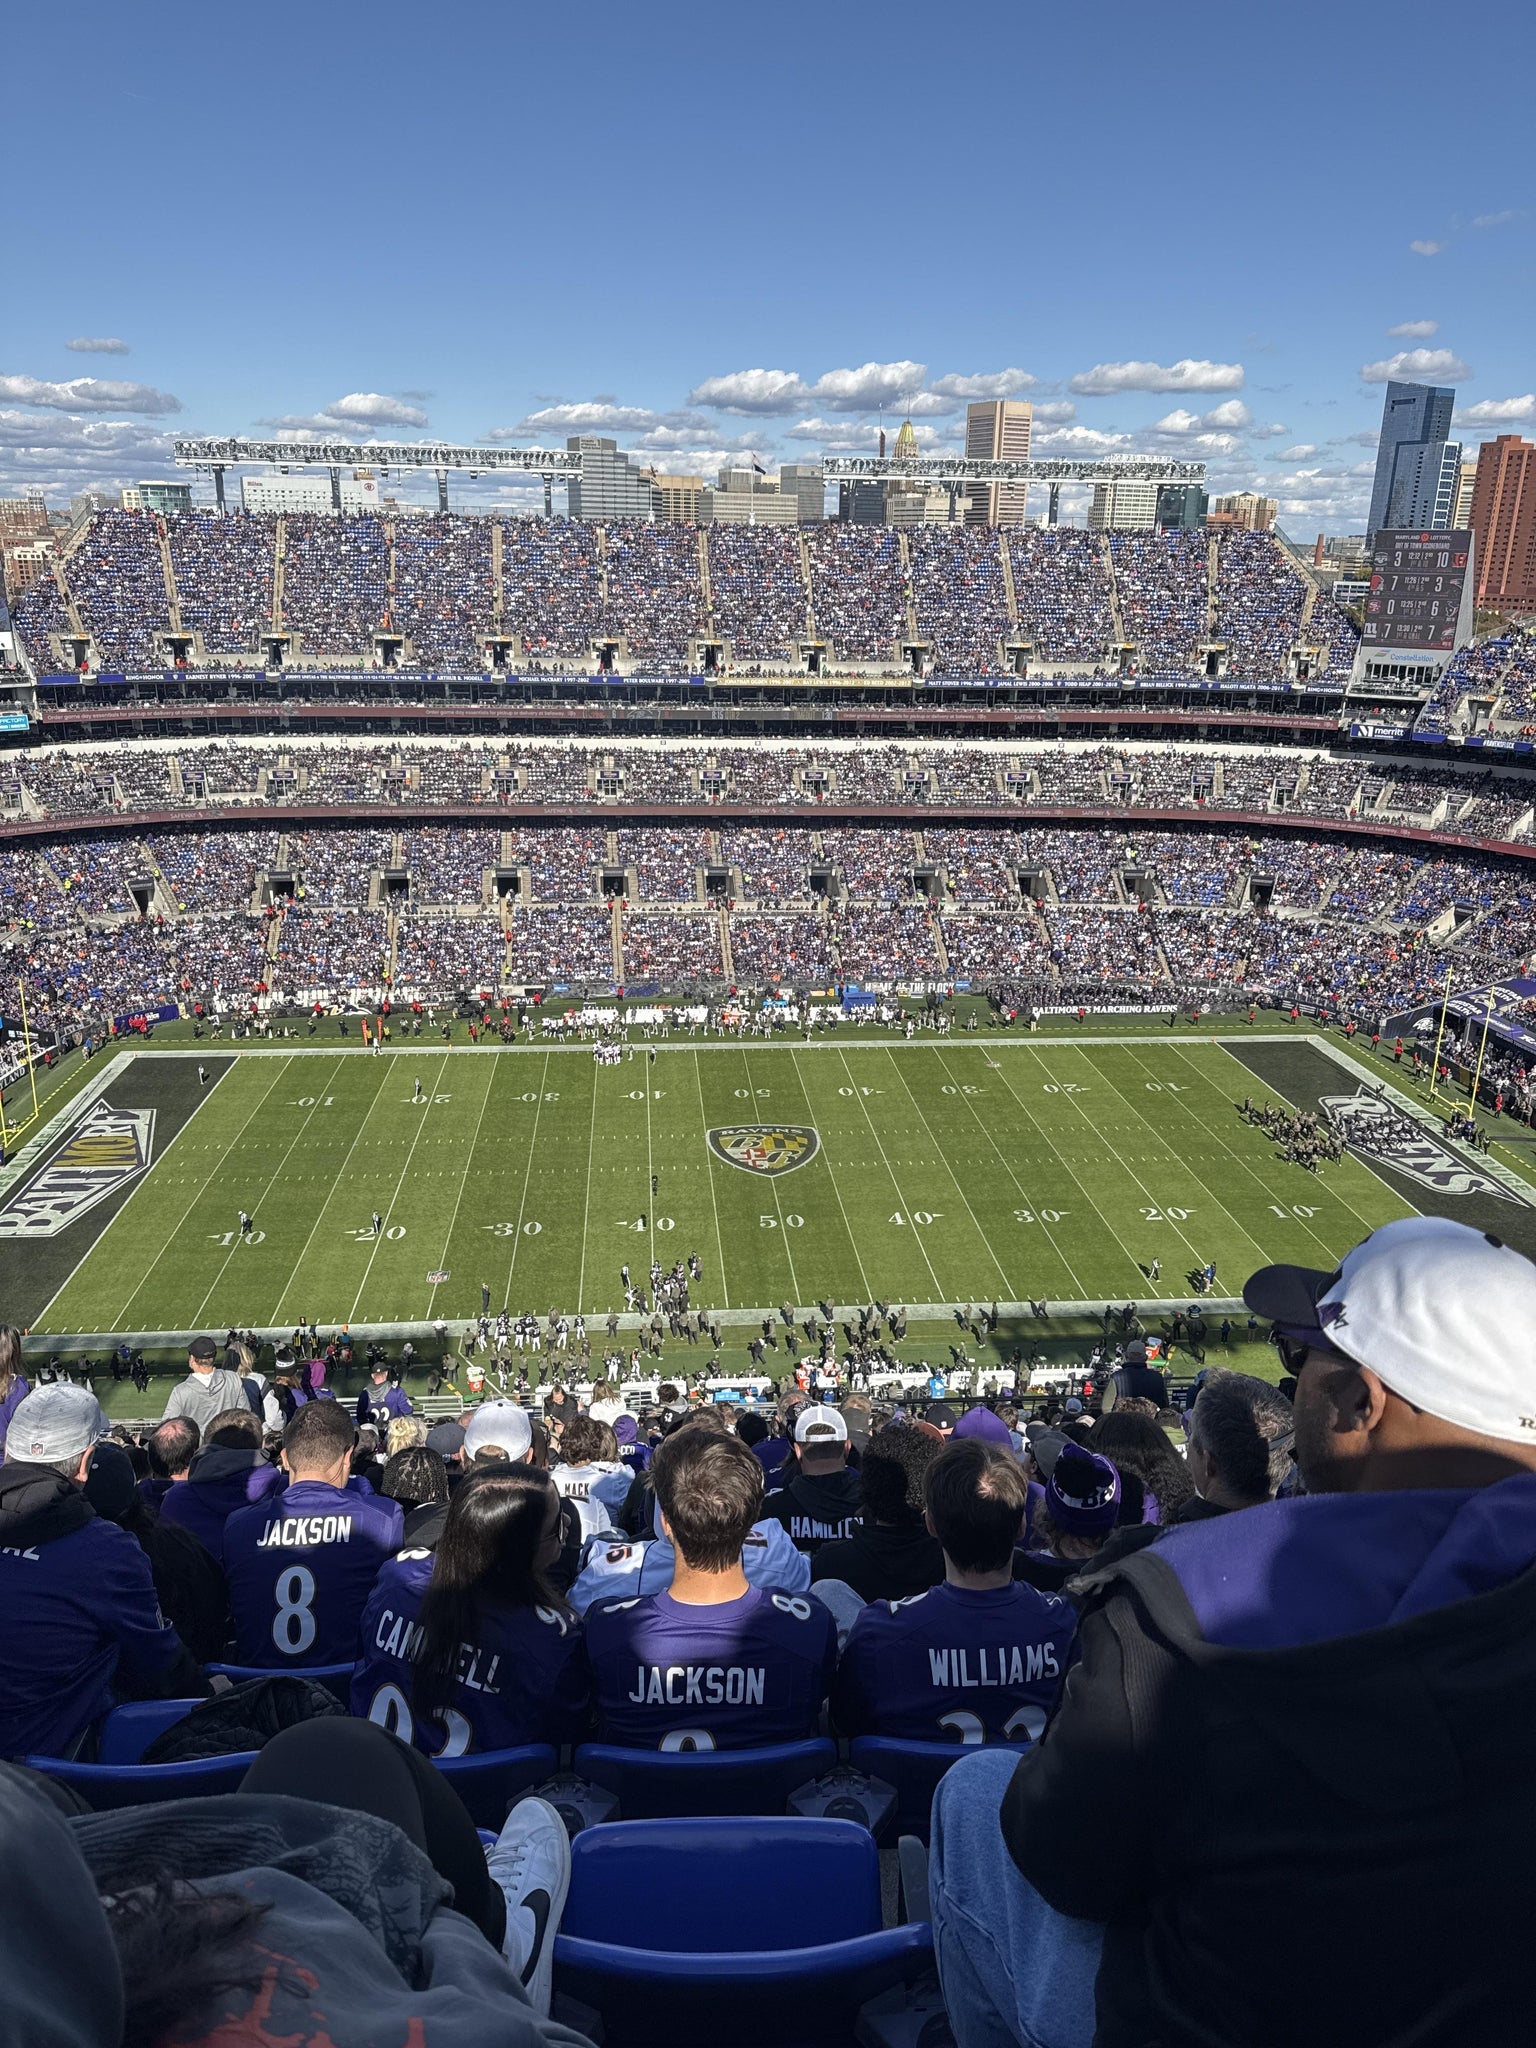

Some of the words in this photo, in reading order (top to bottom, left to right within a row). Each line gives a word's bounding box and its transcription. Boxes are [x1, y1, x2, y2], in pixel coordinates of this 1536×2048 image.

[1394, 551, 1402, 567] 3
[1436, 552, 1449, 568] 10
[1391, 575, 1399, 591] 7
[1434, 576, 1443, 592] 3
[1387, 599, 1395, 615] 0
[1431, 600, 1439, 616] 6
[1384, 623, 1392, 639] 7
[1427, 625, 1435, 640] 7
[1390, 653, 1434, 662] Constellation
[128, 711, 146, 719] pickup
[153, 710, 173, 718] delivery
[1194, 716, 1208, 724] game
[1219, 716, 1243, 724] essentials
[1251, 718, 1269, 726] pickup
[1275, 719, 1293, 727] delivery
[1374, 727, 1404, 736] merritt
[18, 823, 47, 832] essentials
[55, 821, 74, 830] pickup
[81, 818, 104, 828] delivery
[1430, 833, 1455, 842] SAFEWAY
[865, 982, 893, 992] HME
[909, 982, 925, 993] THE
[1092, 1005, 1142, 1014] MARCHING
[1143, 1004, 1178, 1013] RAVENS
[718, 1127, 803, 1135] RAVENS
[1321, 1090, 1512, 1194] RENS
[0, 1106, 152, 1236] BALTIMORE
[888, 1211, 934, 1226] 40
[1013, 1209, 1061, 1223] 30
[1138, 1206, 1189, 1221] 20
[1267, 1204, 1314, 1219] 10
[493, 1221, 543, 1237] 30
[628, 1215, 676, 1232] 40
[759, 1214, 805, 1229] 50
[216, 1230, 266, 1247] 10
[354, 1225, 407, 1242] 20
[564, 1482, 590, 1496] MACK
[256, 1516, 352, 1547] JACKSON
[273, 1566, 317, 1655] 8
[376, 1609, 500, 1694] CAMELL
[929, 1642, 1060, 1687] WILLIAMS
[628, 1666, 766, 1705] JACKSON
